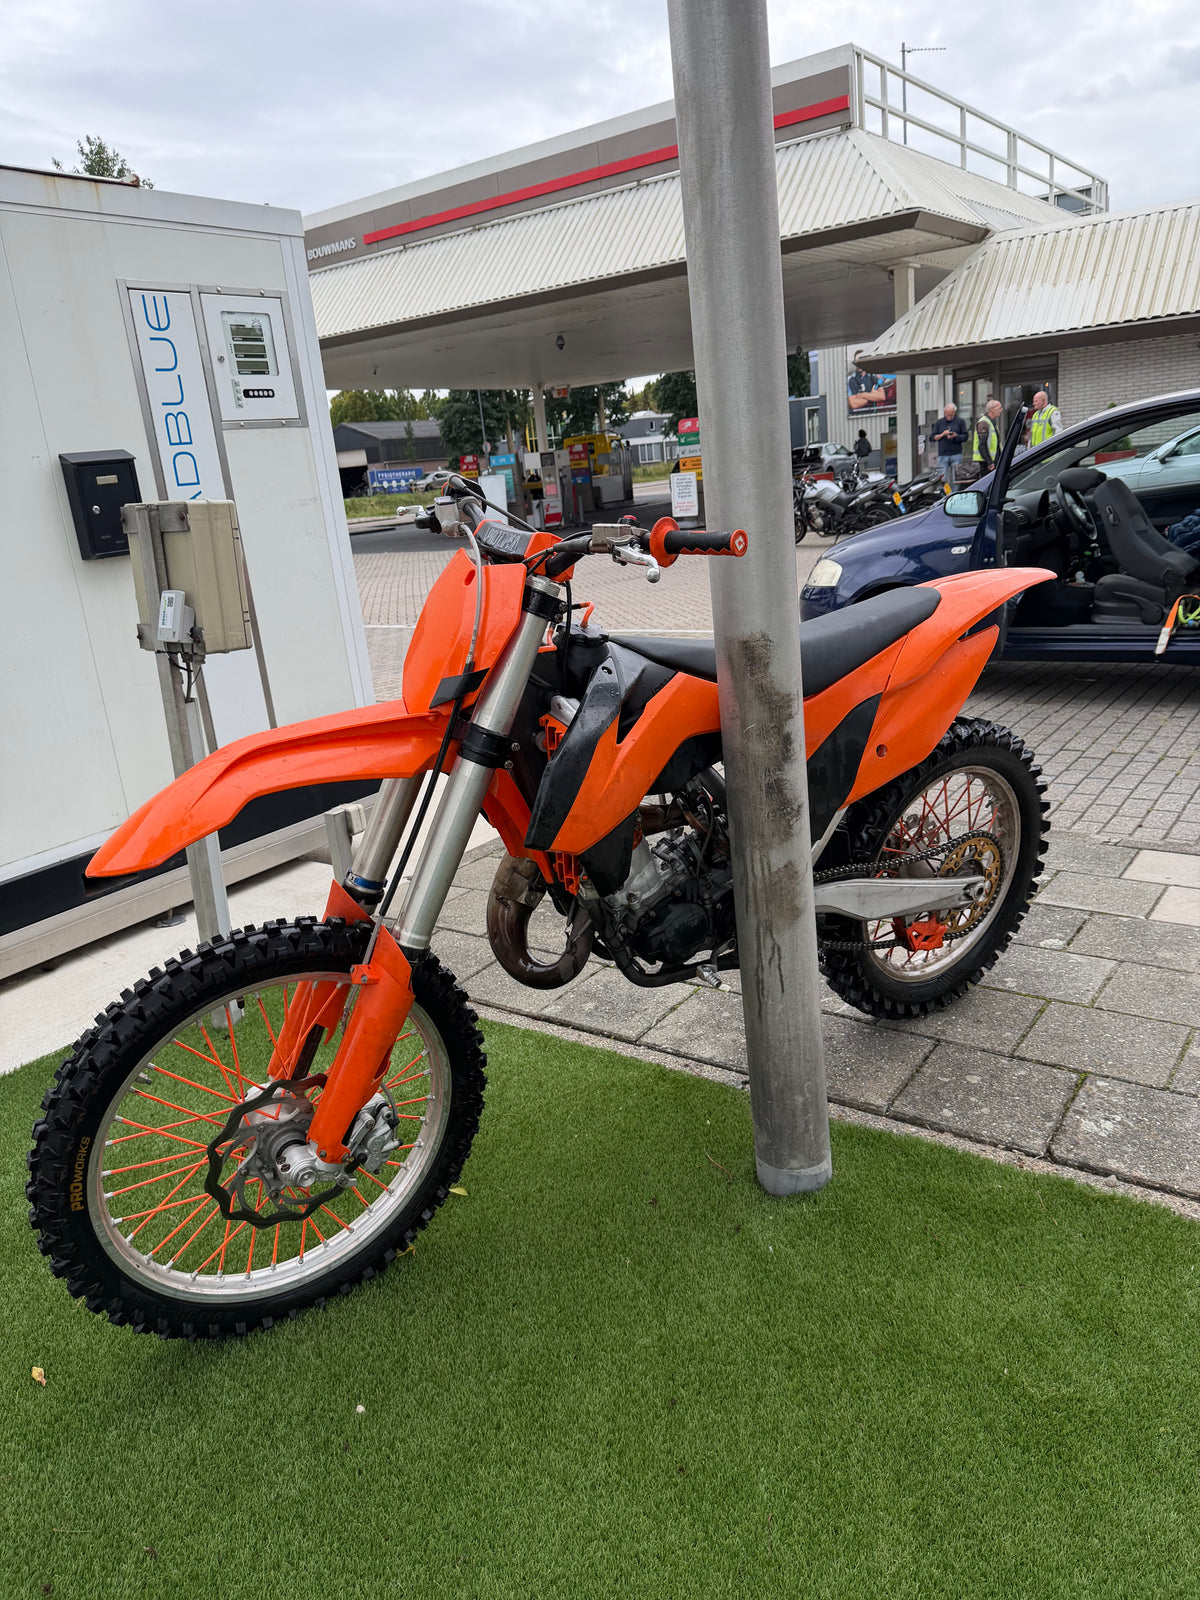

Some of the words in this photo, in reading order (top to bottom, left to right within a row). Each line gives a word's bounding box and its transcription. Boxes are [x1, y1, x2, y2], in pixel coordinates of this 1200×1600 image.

[307, 237, 356, 260] BOUWMANS
[141, 294, 202, 500] DBLUE
[69, 1136, 91, 1212] PROWORKS
